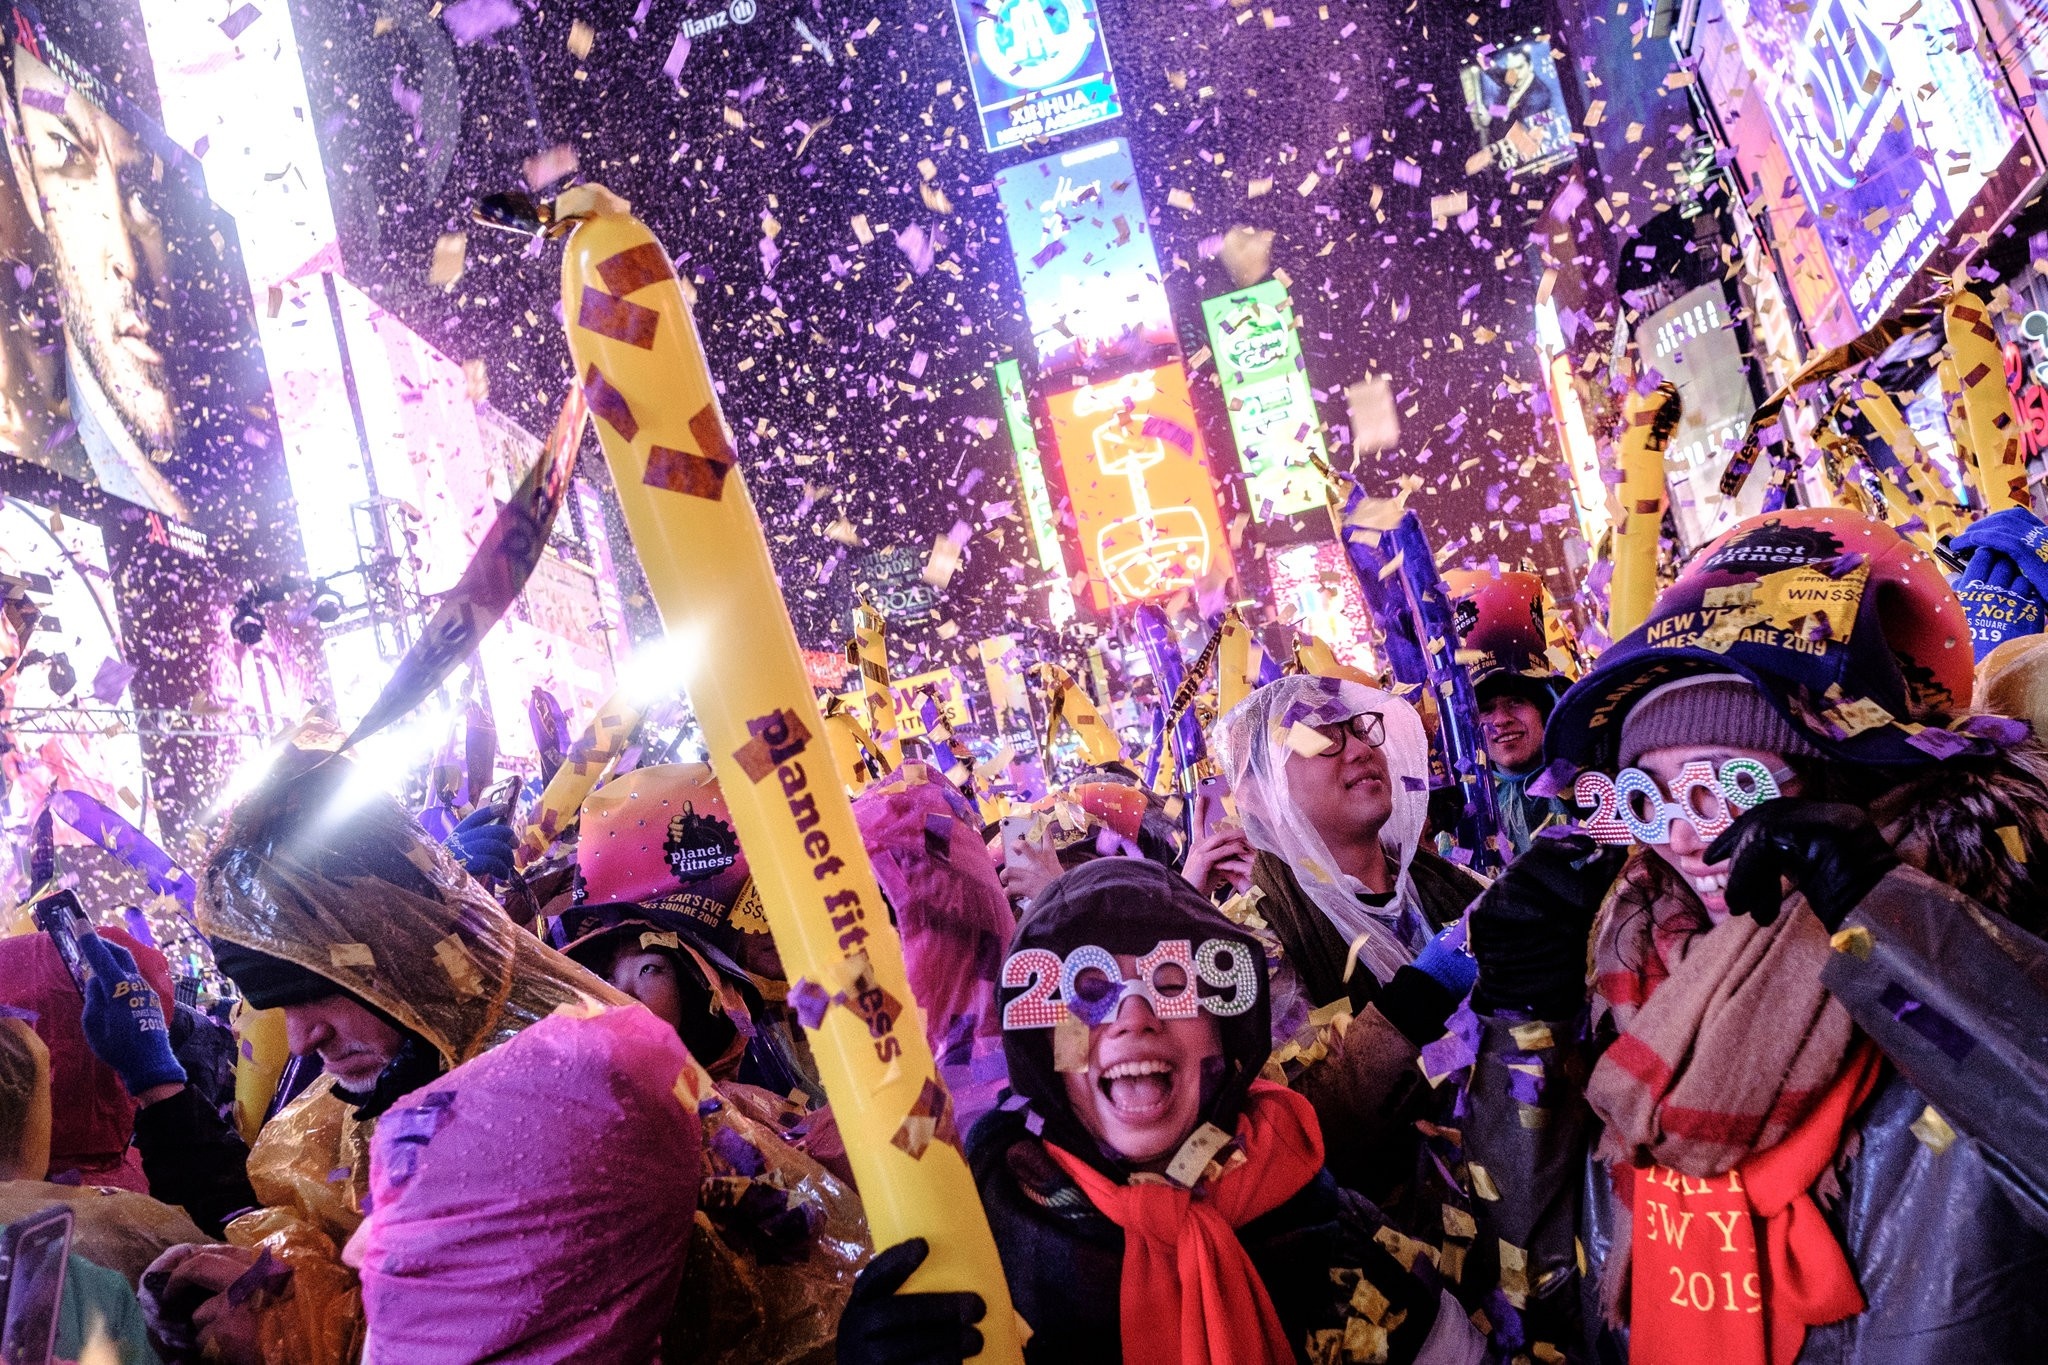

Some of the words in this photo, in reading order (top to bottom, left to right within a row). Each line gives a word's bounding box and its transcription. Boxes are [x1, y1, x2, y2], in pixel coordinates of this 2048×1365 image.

[1010, 90, 1090, 127] XINHUA
[1788, 588, 1828, 601] WIN
[1456, 616, 1476, 633] ness
[1647, 612, 1695, 643] NEW
[1974, 617, 2007, 631] SQUARE
[1740, 628, 1778, 647] ARE
[671, 843, 723, 864] planet
[679, 854, 733, 873] fitness
[746, 708, 846, 881] planet
[823, 889, 903, 1064] fitess
[658, 901, 697, 919] SQUARE
[697, 911, 720, 929] 2019
[702, 896, 727, 918] EVE
[1002, 938, 1258, 1031] 2019
[1669, 1265, 1762, 1314] 2019
